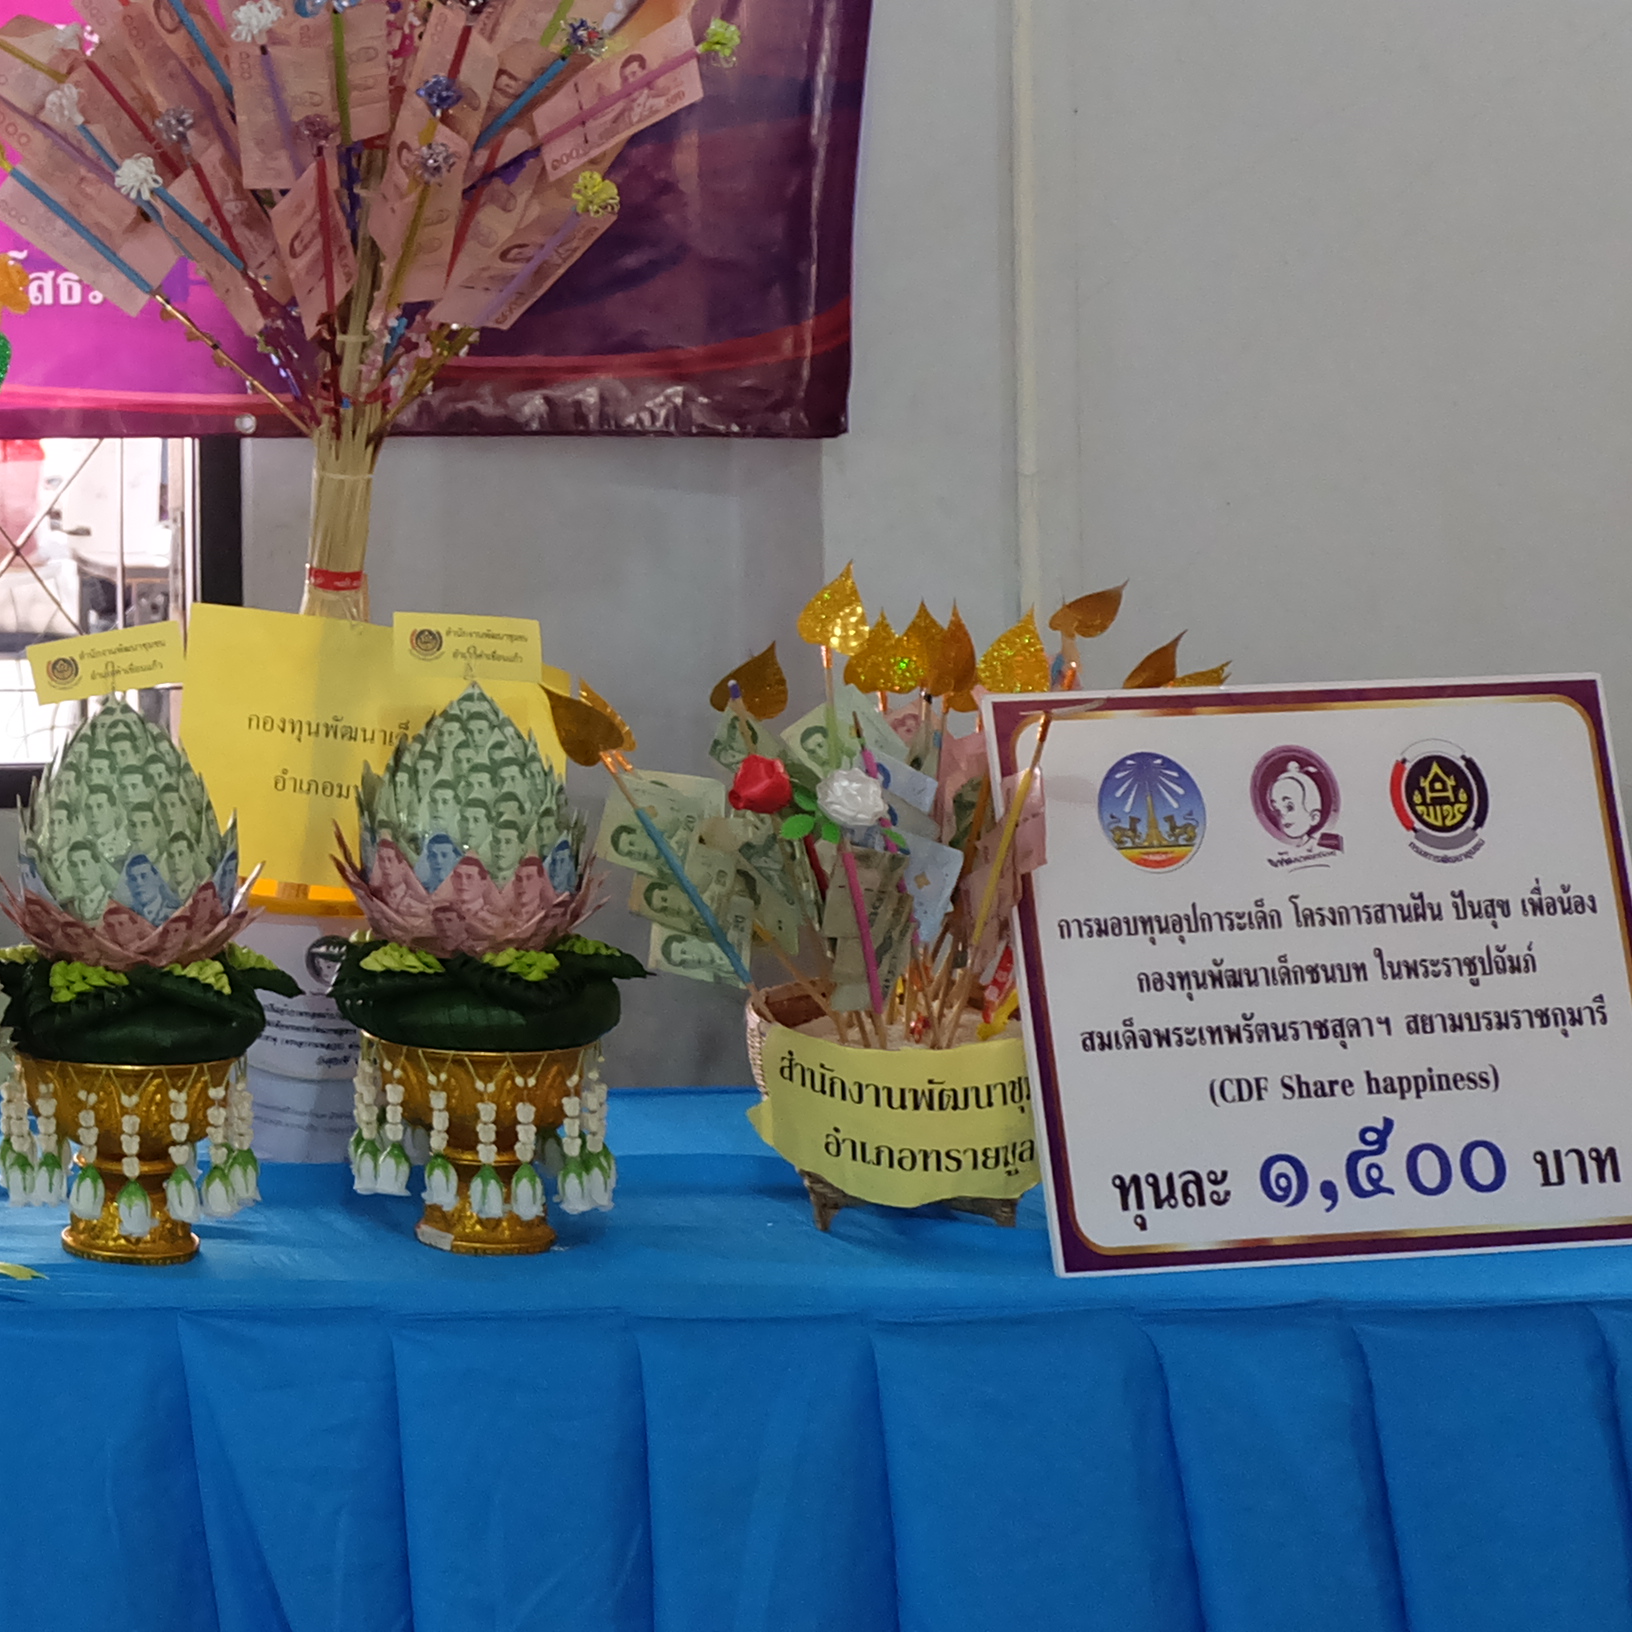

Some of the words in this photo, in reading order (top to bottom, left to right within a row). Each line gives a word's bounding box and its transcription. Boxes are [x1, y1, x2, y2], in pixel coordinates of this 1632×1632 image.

[247, 714, 411, 747] กองทุนพัฒนาเด็
[1057, 897, 1283, 946] การมอบทุนอุปการะเด็ก
[1288, 890, 1444, 929] โครงการสานฝัน
[1450, 889, 1512, 929] ปันสุข
[1520, 878, 1599, 918] เพื่อน้อง
[1136, 953, 1369, 1002] กองทุนพัฒนาเด็กชนบท
[1373, 940, 1537, 987] ในพระราชูปถัมภ์
[1079, 1011, 1392, 1053] สมเด็จพระเทพรัตนราชสุดาฯ
[1404, 993, 1609, 1039] สยามบรมราชกุมารี
[1208, 1073, 1270, 1109] (CDF
[1281, 1069, 1355, 1102] Share
[1365, 1063, 1502, 1101] happiness)
[1112, 1168, 1233, 1232] ทุนละ
[1258, 1116, 1509, 1213] ๑,๕๐๐
[1532, 1142, 1622, 1190] บาท
